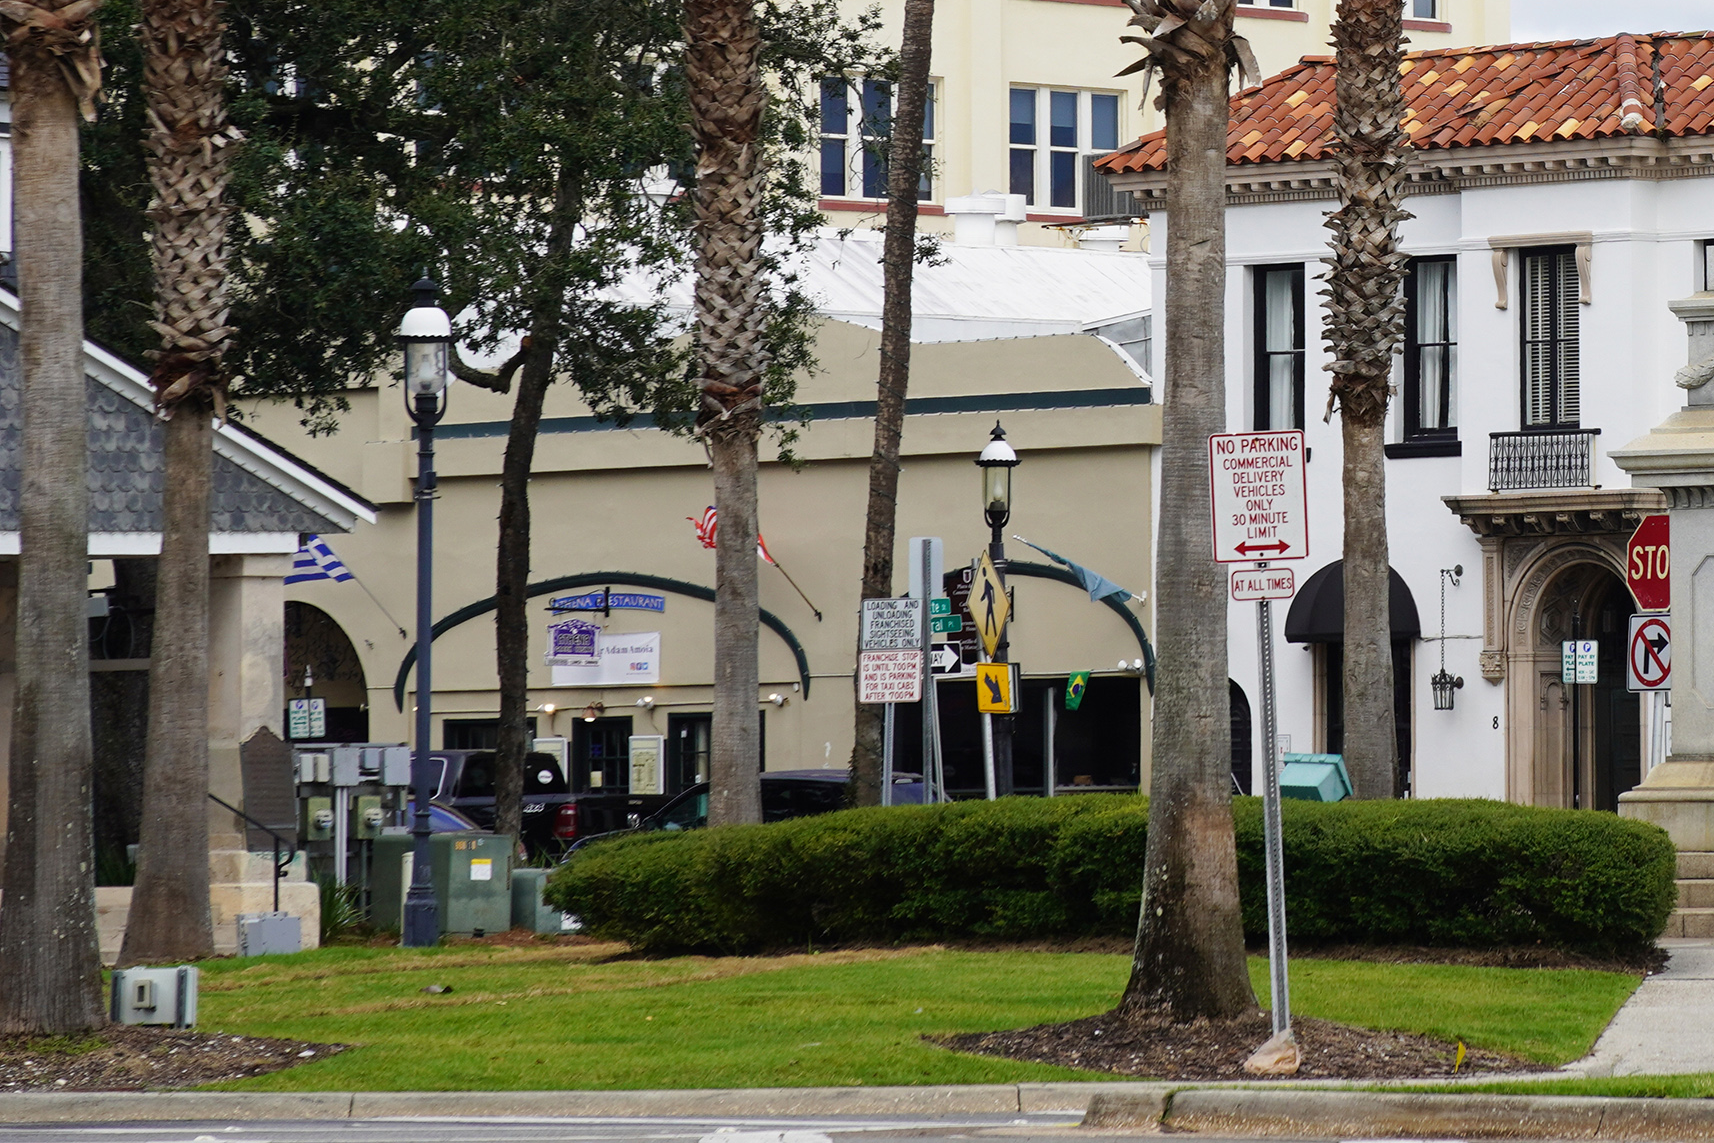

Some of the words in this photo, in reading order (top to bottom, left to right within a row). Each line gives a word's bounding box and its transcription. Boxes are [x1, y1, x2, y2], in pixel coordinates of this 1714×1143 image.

[1216, 440, 1235, 455] NO
[1241, 436, 1298, 454] PARKING
[1223, 456, 1293, 470] COMMERCIAL
[1232, 470, 1285, 484] DELIVERY
[1233, 484, 1286, 498] VEHICLES
[1246, 499, 1274, 511] ONLY
[1232, 514, 1247, 526] 30
[1249, 512, 1289, 526] MINUTE
[1247, 526, 1278, 539] LIMIT
[1631, 545, 1670, 580] STO
[1234, 579, 1244, 592] AT
[1247, 579, 1265, 591] ALL
[1266, 577, 1293, 591] TIMES
[867, 601, 898, 611] LOADING
[904, 600, 919, 609] AND
[872, 610, 913, 620] UNLOADING
[870, 619, 915, 629] FRANCHISED
[869, 629, 915, 639] SIGHTSEEING
[864, 639, 899, 648] VEHICLES
[902, 638, 920, 648] ONLY
[863, 653, 899, 662] FRANCHISE
[902, 652, 919, 661] STOP
[863, 664, 870, 672] IS
[872, 663, 890, 672] UNTIL
[864, 673, 879, 681] AND
[880, 672, 887, 681] IS
[888, 671, 917, 681] PARKING
[865, 683, 878, 691] FOR
[881, 682, 895, 691] TAXI
[897, 681, 915, 690] CABS
[865, 692, 886, 701] AFTER
[1493, 716, 1499, 729] 8
